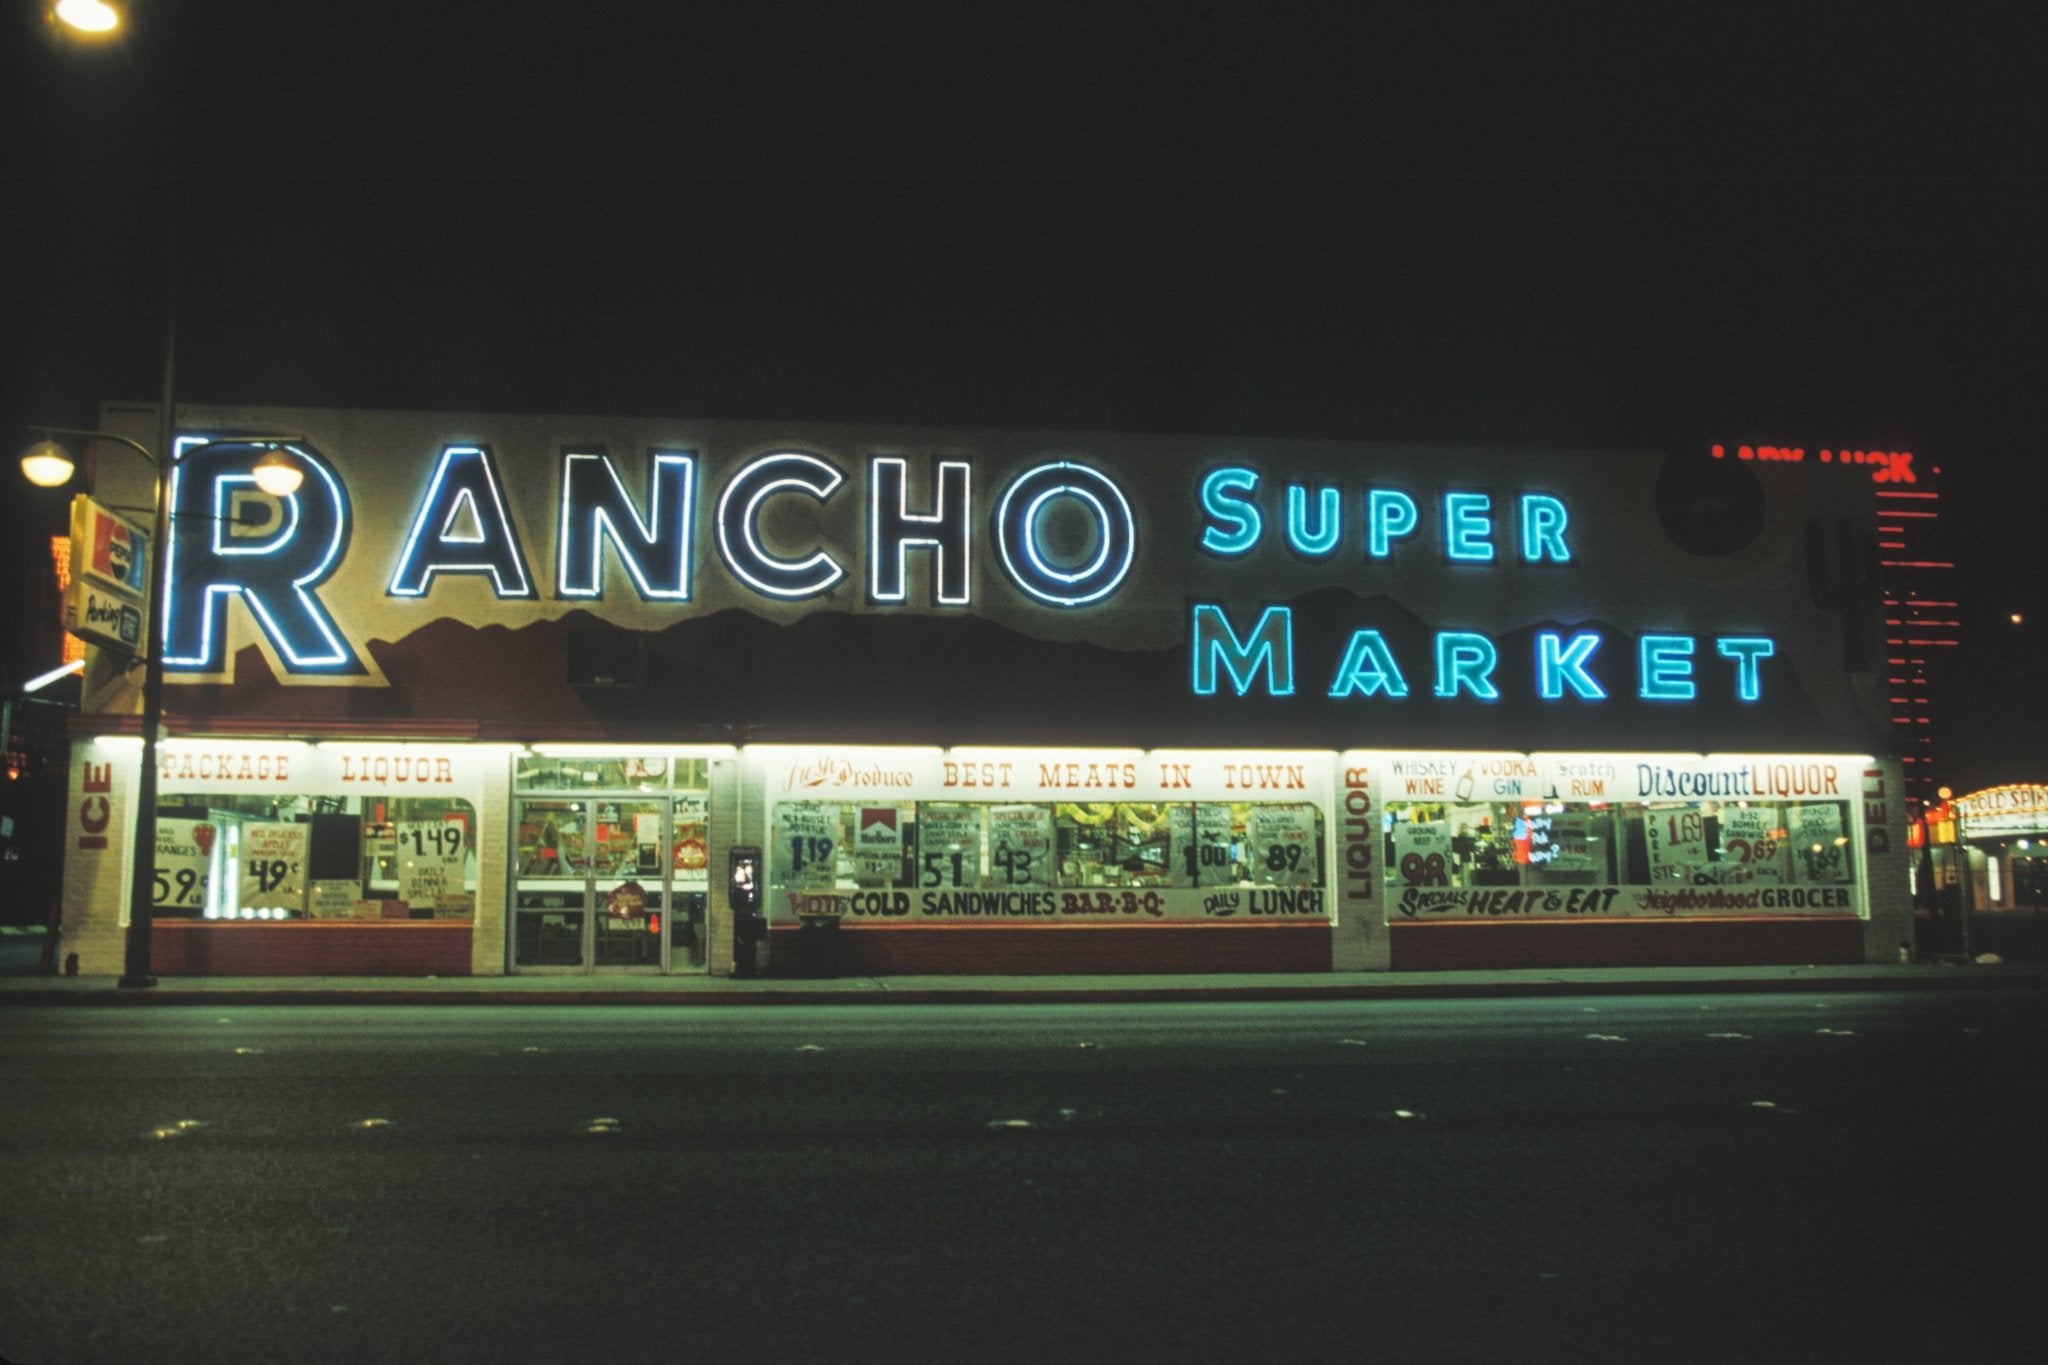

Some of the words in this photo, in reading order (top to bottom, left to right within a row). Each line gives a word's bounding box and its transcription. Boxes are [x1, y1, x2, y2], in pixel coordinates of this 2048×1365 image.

[1201, 466, 1572, 564] SUPER
[163, 430, 1140, 680] RANCHO
[1192, 604, 1775, 701] MARKET
[162, 754, 289, 781] PACKAGE
[341, 756, 454, 785] LIQUOR
[943, 762, 1013, 788] BEST
[1039, 763, 1136, 789] MEATS
[1160, 764, 1192, 789] IN
[1223, 765, 1305, 790] TOWN
[1392, 760, 1457, 776] WHISKEY
[1481, 760, 1537, 777] VODKA
[1636, 763, 1750, 797] Discount
[1752, 764, 1839, 796] LIQUOR
[1405, 779, 1445, 796] WINE
[1572, 779, 1605, 797] RUM
[1969, 792, 2006, 811] GOLD
[78, 761, 112, 850] ICE
[1863, 769, 1890, 854] DELI
[1345, 767, 1373, 901] LIQUOR
[851, 891, 910, 916] COLD
[922, 890, 1056, 916] SANDWICHES
[1204, 891, 1240, 911] DAILY
[1250, 890, 1324, 915] LUNCH
[1466, 890, 1546, 916] HEAT
[1565, 887, 1620, 913] EAT
[1637, 887, 1760, 915] Neighborhood
[1762, 888, 1850, 909] GROCER
